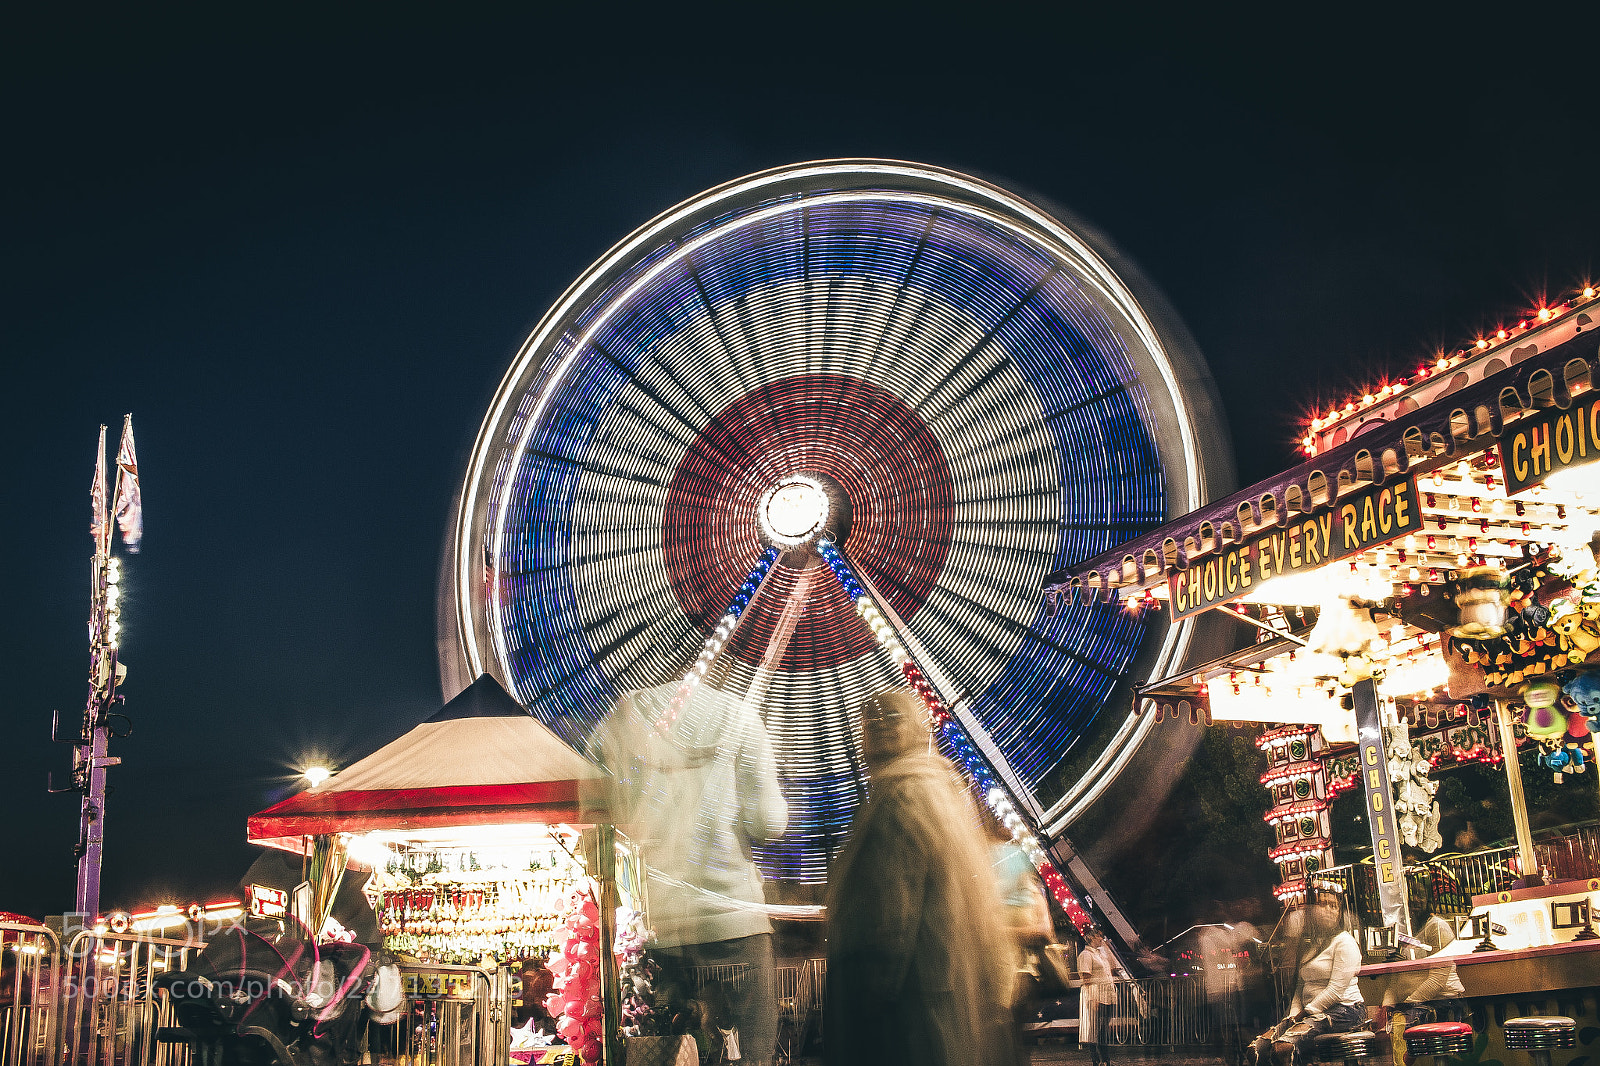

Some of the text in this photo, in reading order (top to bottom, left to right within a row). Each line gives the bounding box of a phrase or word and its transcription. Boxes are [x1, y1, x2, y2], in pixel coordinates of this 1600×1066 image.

[1176, 483, 1410, 612] CHOICE EVERY RACE
[1366, 746, 1394, 883] CHOICE
[402, 972, 468, 995] EXIT
